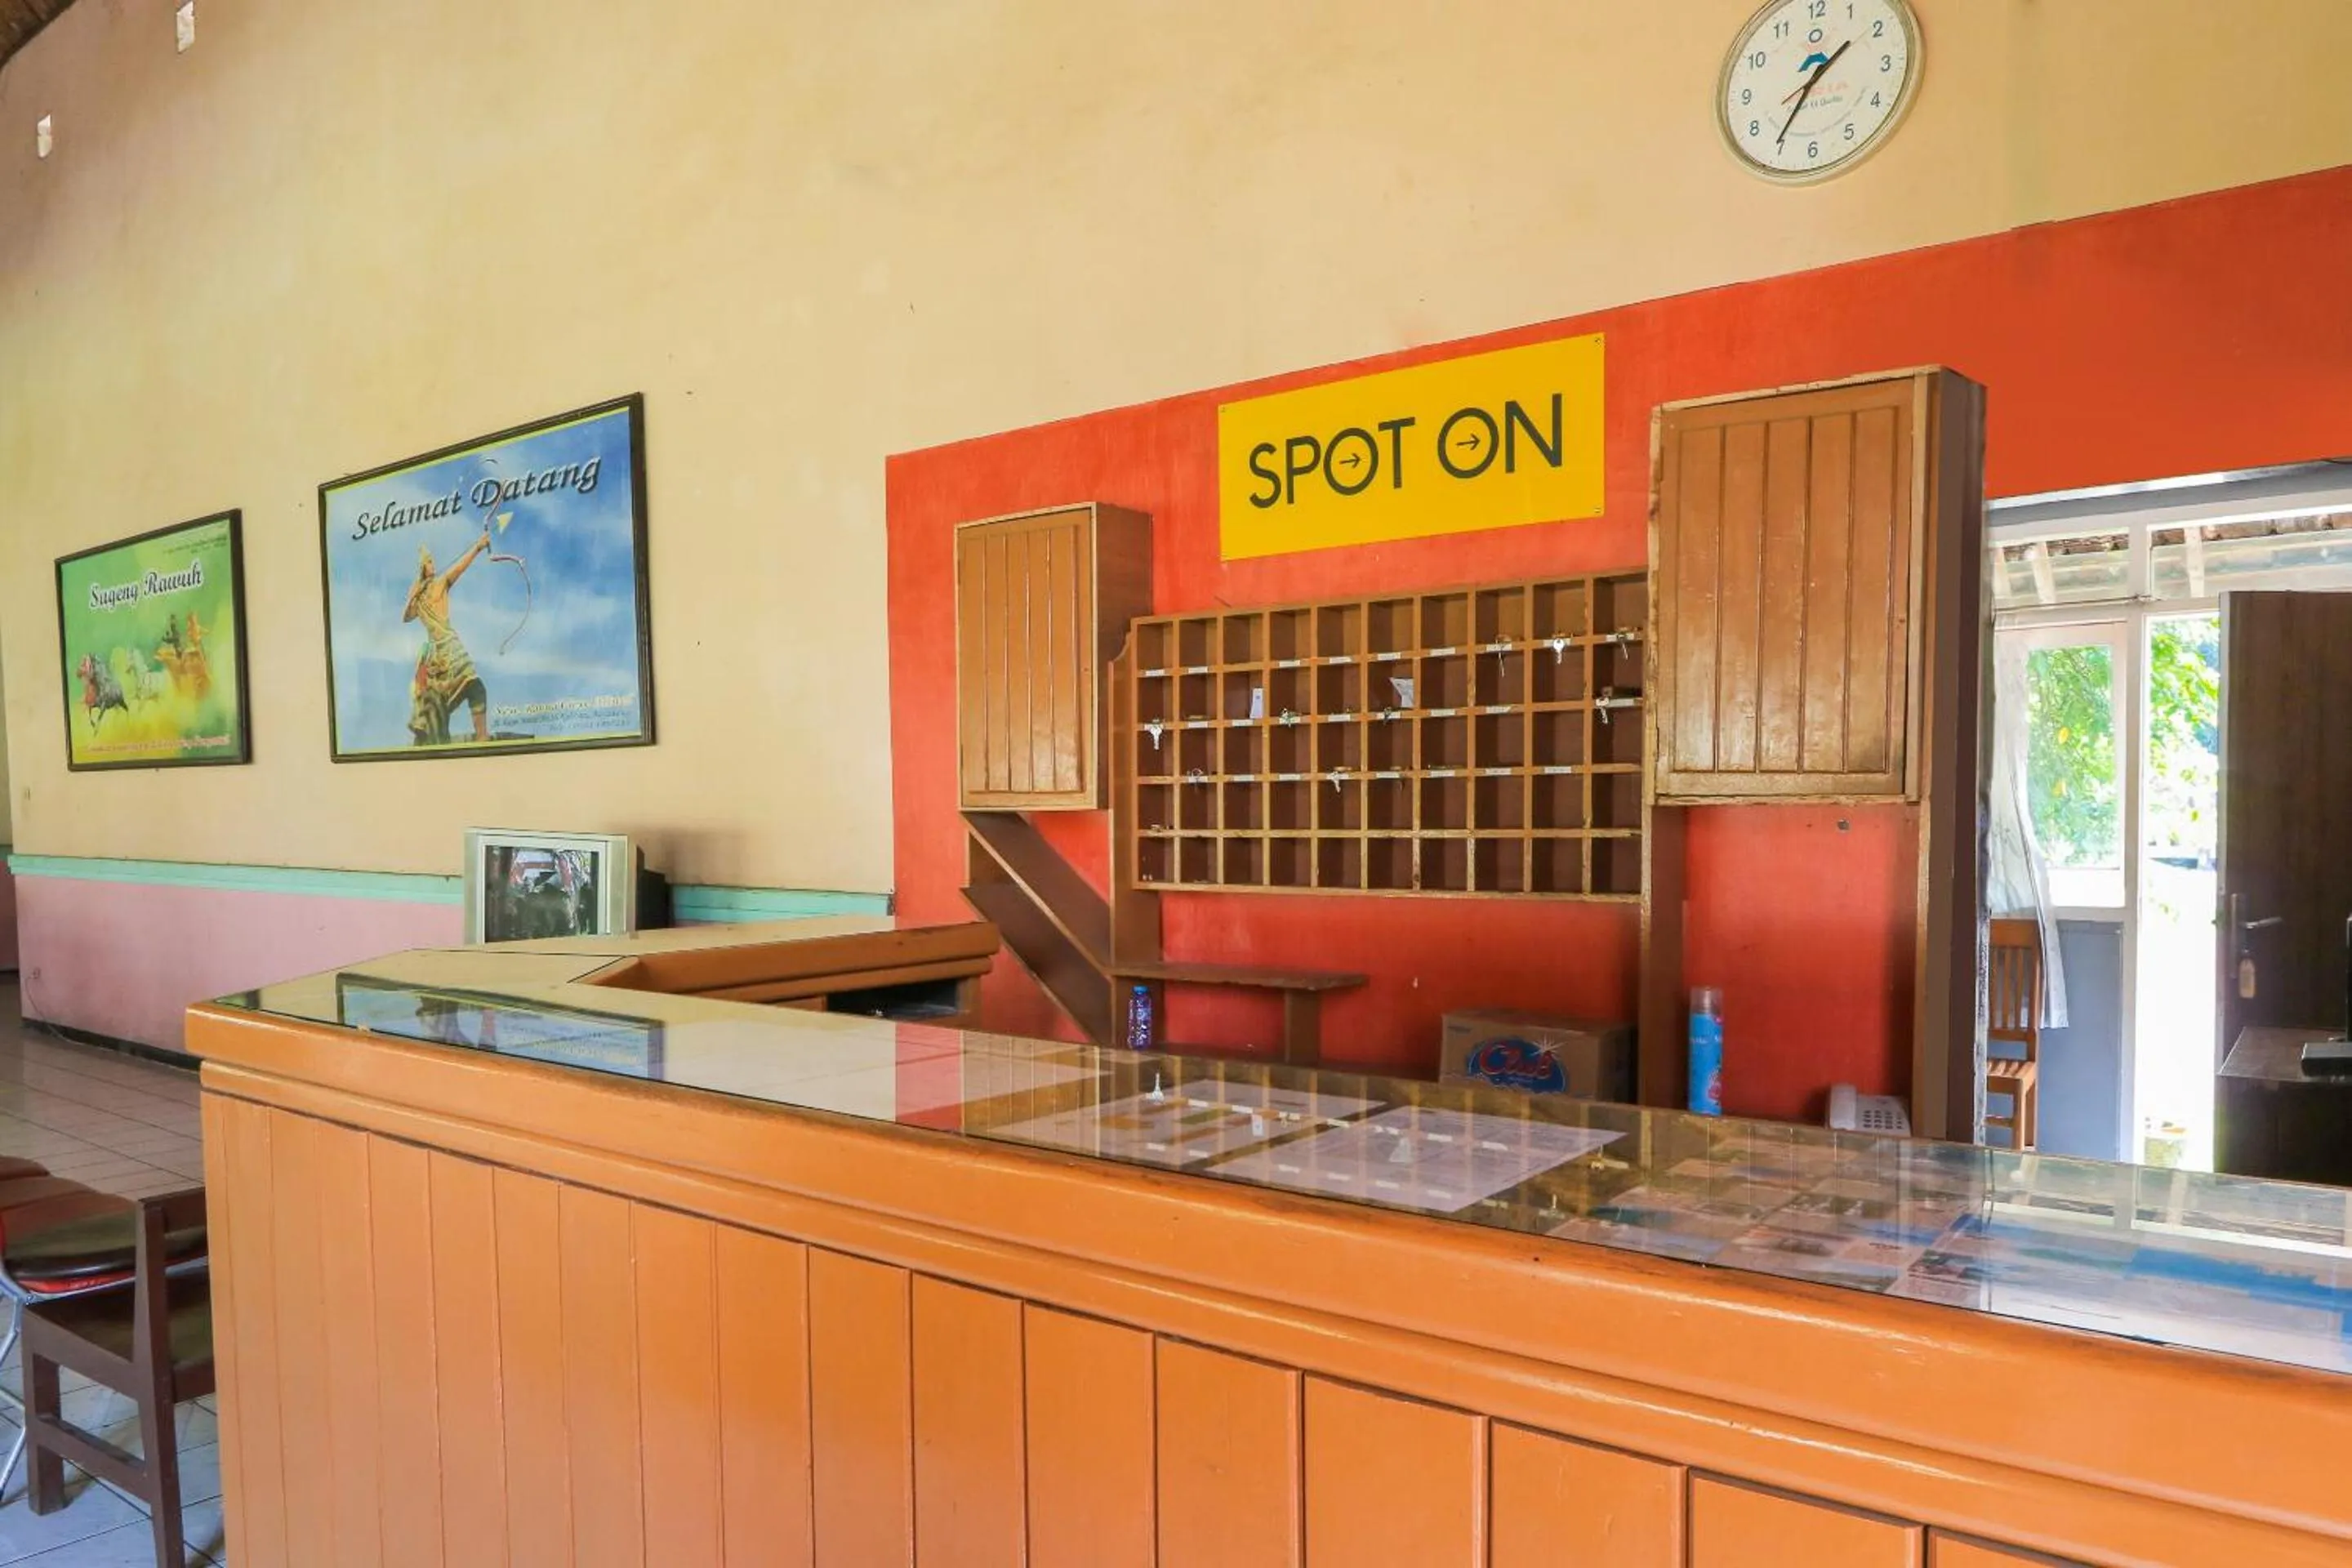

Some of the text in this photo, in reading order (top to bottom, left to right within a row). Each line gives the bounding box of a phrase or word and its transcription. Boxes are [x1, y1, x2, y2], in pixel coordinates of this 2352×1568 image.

[1807, 0, 1826, 20] 12
[1846, 2, 1853, 20] 1
[1773, 21, 1789, 38] 11
[1872, 20, 1883, 38] 2
[1748, 51, 1766, 70] 10
[1880, 54, 1891, 72] 3
[1741, 88, 1752, 105] 9
[1869, 91, 1881, 108] 4
[1748, 120, 1760, 137] 8
[1843, 123, 1854, 140] 5
[1776, 139, 1785, 155] 7
[1807, 141, 1818, 158] 6
[1249, 393, 1562, 509] SPOT ON
[352, 456, 601, 541] Selamat Datang
[90, 560, 202, 611] Sugeng Rawuh
